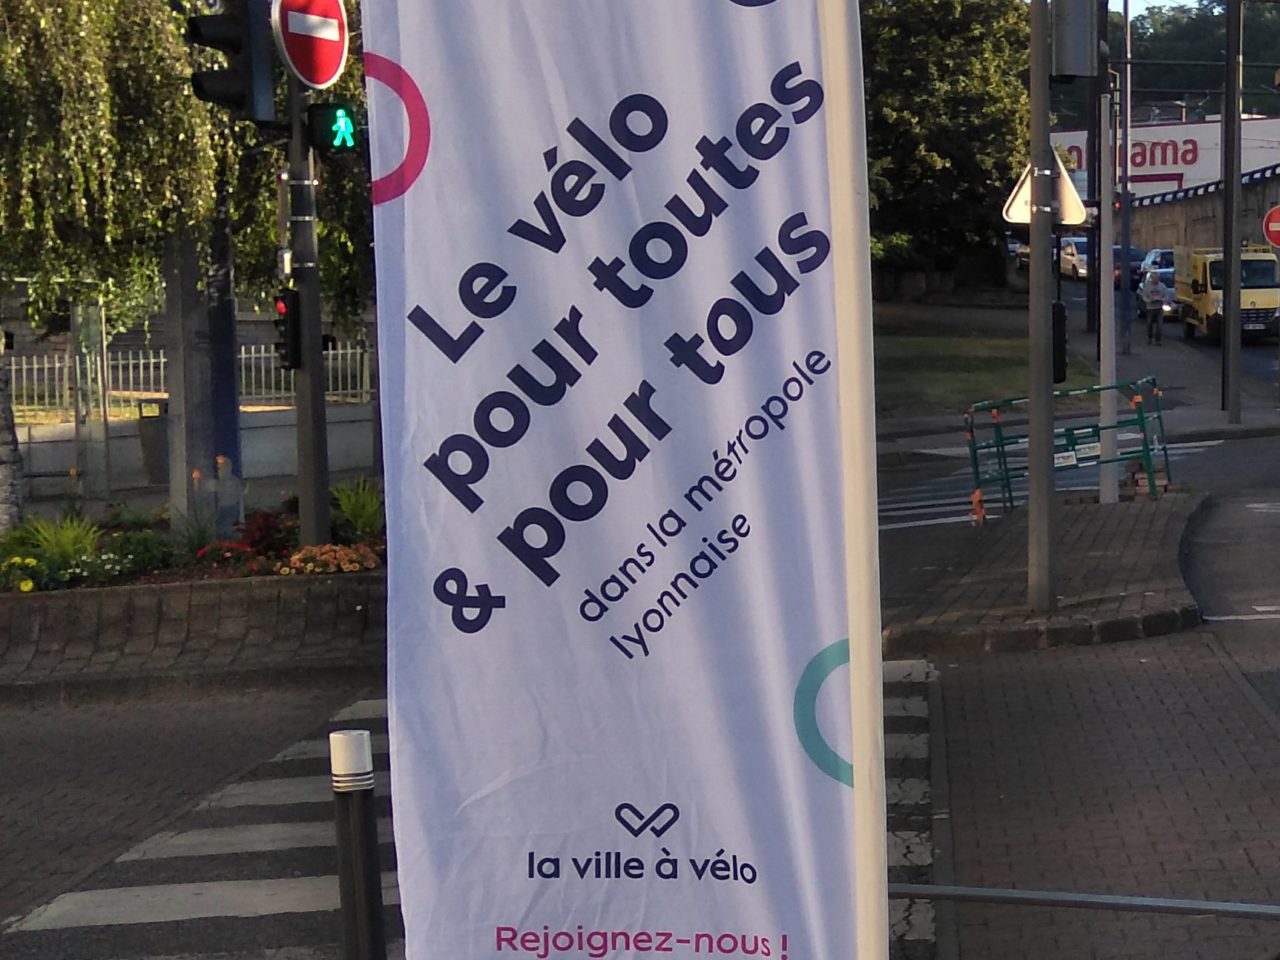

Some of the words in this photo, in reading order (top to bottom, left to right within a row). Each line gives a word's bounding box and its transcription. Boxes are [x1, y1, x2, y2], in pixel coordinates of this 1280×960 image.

[407, 262, 518, 363] Le
[507, 94, 669, 254] vélo
[424, 305, 598, 513] pour
[587, 61, 825, 309] toutes
[433, 567, 506, 634] &
[497, 379, 672, 587] pour
[664, 211, 831, 385] tous
[579, 542, 655, 622] dans
[646, 508, 688, 548] la
[684, 348, 832, 513] métropole
[609, 512, 751, 660] lyonnaise
[496, 925, 771, 959] Rejoignez-nous
[780, 934, 788, 960] !
[528, 851, 561, 880] la
[571, 850, 645, 880] ville
[655, 846, 679, 880] à
[689, 848, 757, 885] vélo
